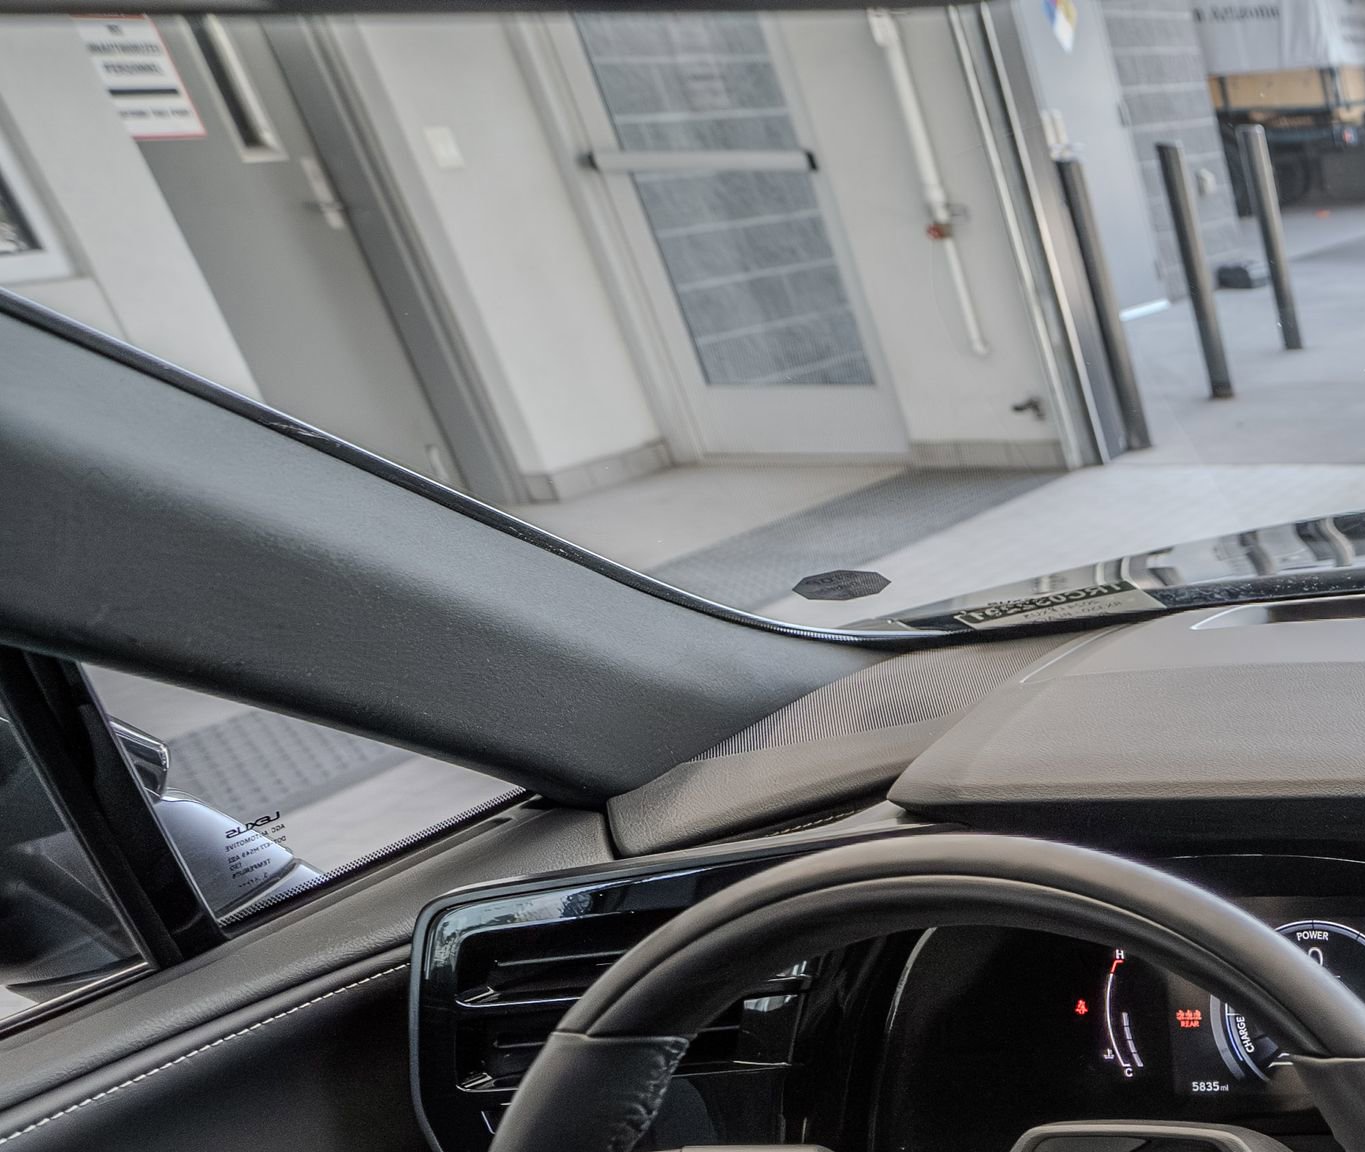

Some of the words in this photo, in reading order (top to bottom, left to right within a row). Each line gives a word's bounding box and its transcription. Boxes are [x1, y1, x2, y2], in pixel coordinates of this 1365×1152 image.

[1296, 931, 1329, 941] POWER
[1115, 949, 1125, 959] H
[1236, 1016, 1255, 1053] CHARGE
[1125, 1068, 1133, 1077] C
[1192, 1082, 1220, 1092] 5835
